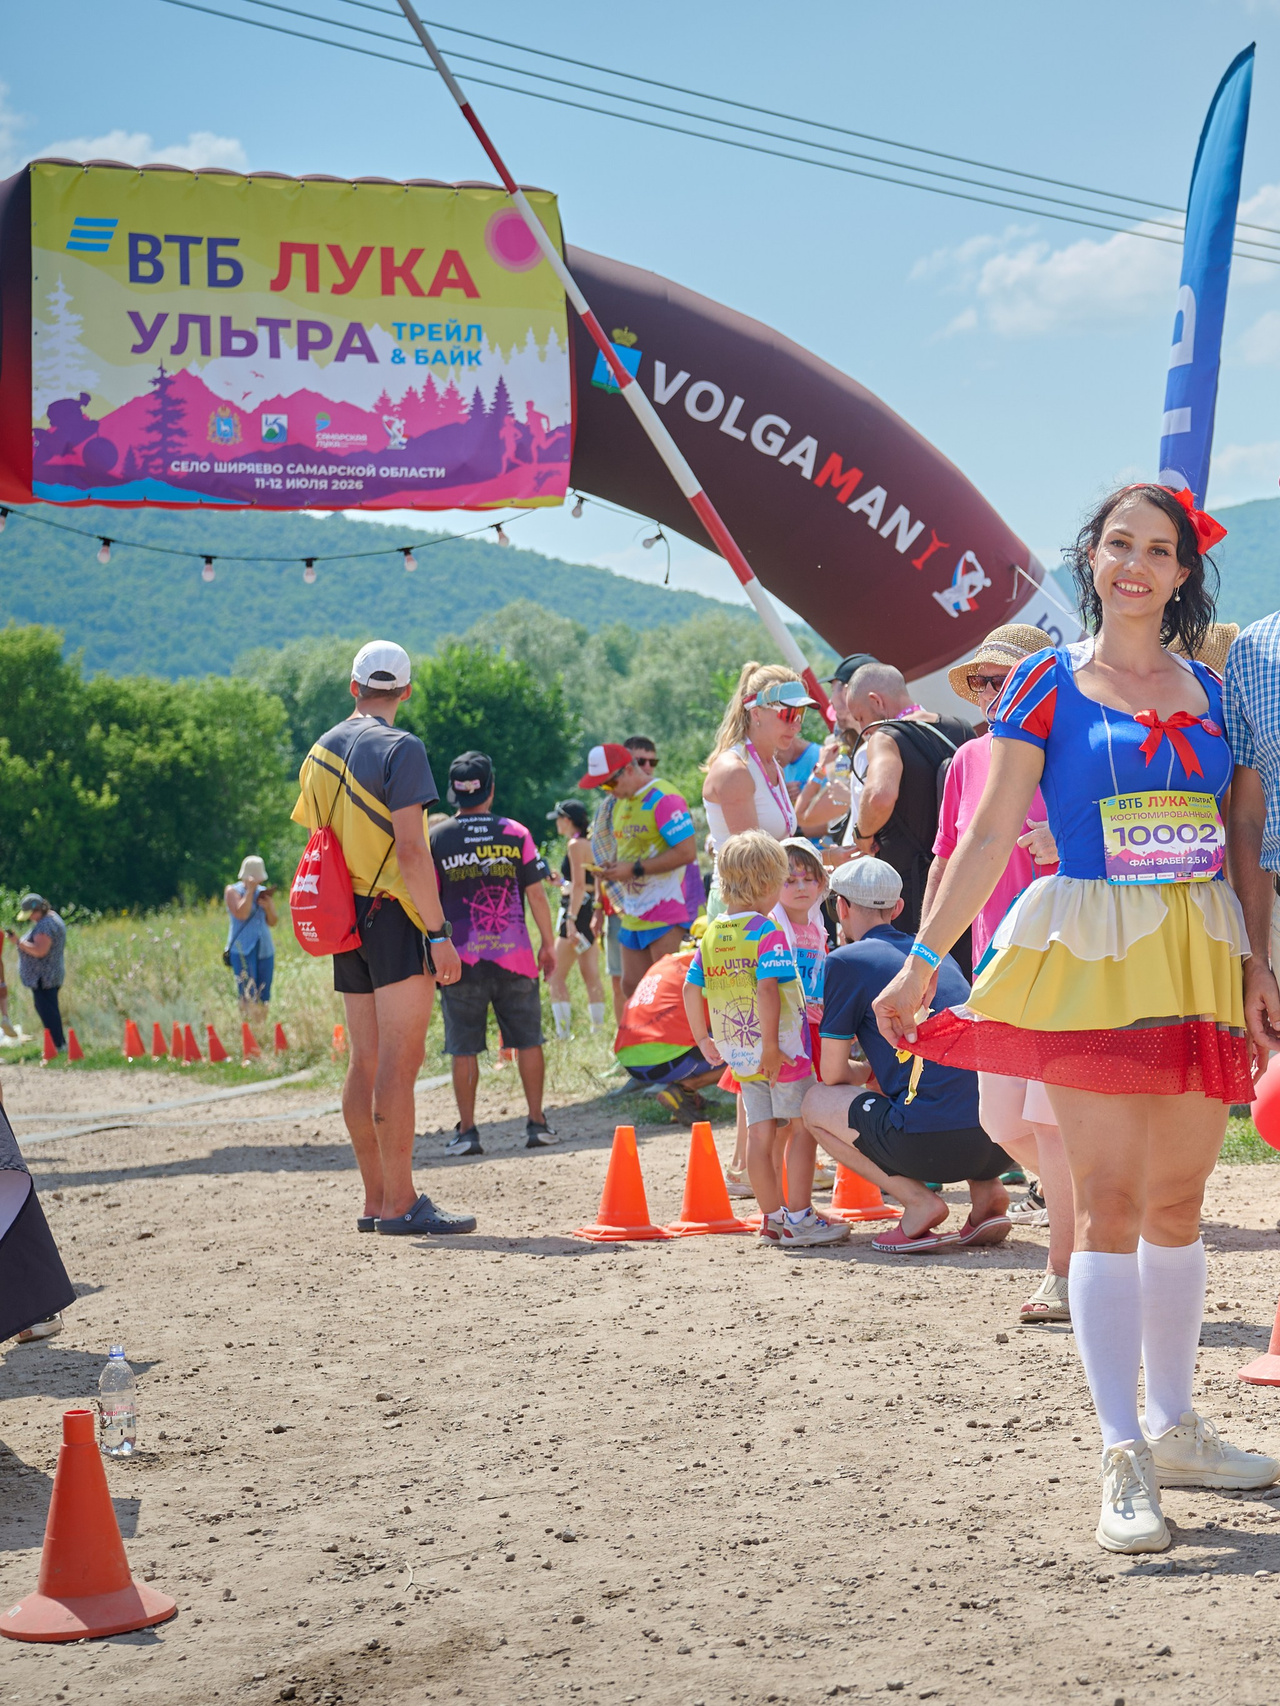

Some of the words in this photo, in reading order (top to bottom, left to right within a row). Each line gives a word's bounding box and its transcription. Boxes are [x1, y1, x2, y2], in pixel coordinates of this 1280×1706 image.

[127, 232, 244, 289] ВТБ
[269, 241, 482, 299] ЛУКА
[126, 310, 380, 364] УЛЬТРА
[391, 318, 483, 343] ТРЕЙЛ
[390, 347, 406, 365] &
[414, 345, 483, 367] БАЙК
[170, 460, 211, 473] СЕЛО
[213, 461, 284, 475] ШИРЯЕВО
[286, 462, 376, 477] САМАРСКОЙ
[378, 465, 446, 479] ОБЛАСТИ
[254, 478, 283, 490] 11-12
[285, 478, 328, 491] ИЮЛЯ
[330, 480, 364, 491] 2026
[1118, 798, 1143, 809] ВТБ
[1148, 796, 1188, 807] ЛУКА
[1110, 810, 1213, 822] КОСТЮМИРОВАННЫЙ
[1112, 823, 1218, 847] 10002
[476, 845, 521, 859] ULTRA
[441, 852, 480, 871] LUKA
[1129, 858, 1154, 867] ФАН
[1156, 856, 1186, 865] ЗАБЕГ
[1201, 856, 1208, 864] К
[773, 944, 785, 957] Я
[724, 958, 758, 970] ULTRA
[704, 965, 727, 978] LUKA
